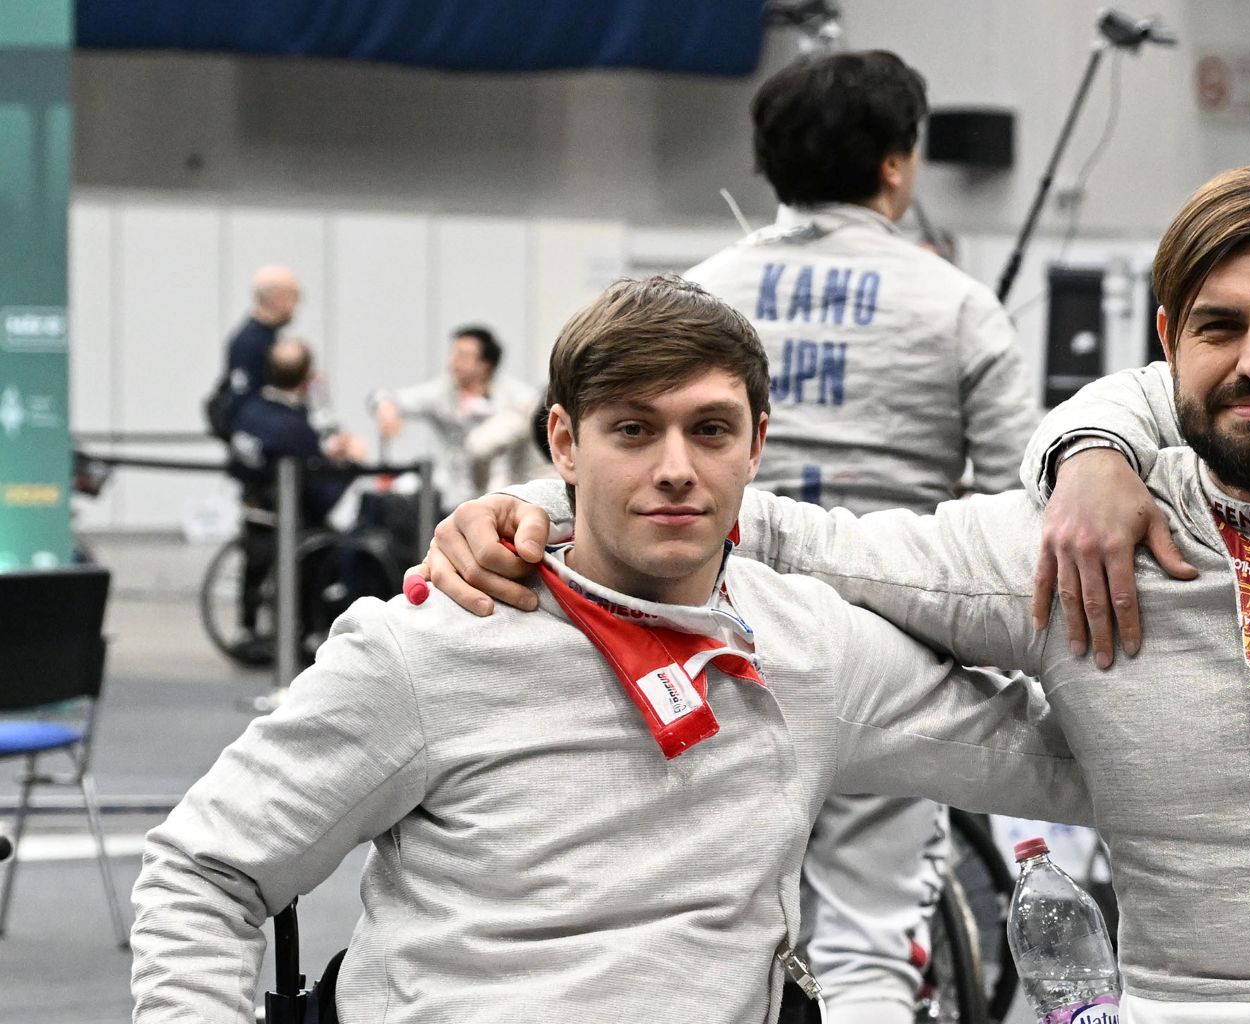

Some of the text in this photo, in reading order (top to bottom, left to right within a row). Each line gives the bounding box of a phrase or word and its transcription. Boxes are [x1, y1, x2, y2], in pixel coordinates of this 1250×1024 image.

[756, 263, 880, 325] KANO
[770, 339, 848, 406] JPN
[656, 671, 683, 705] PRIEUR
